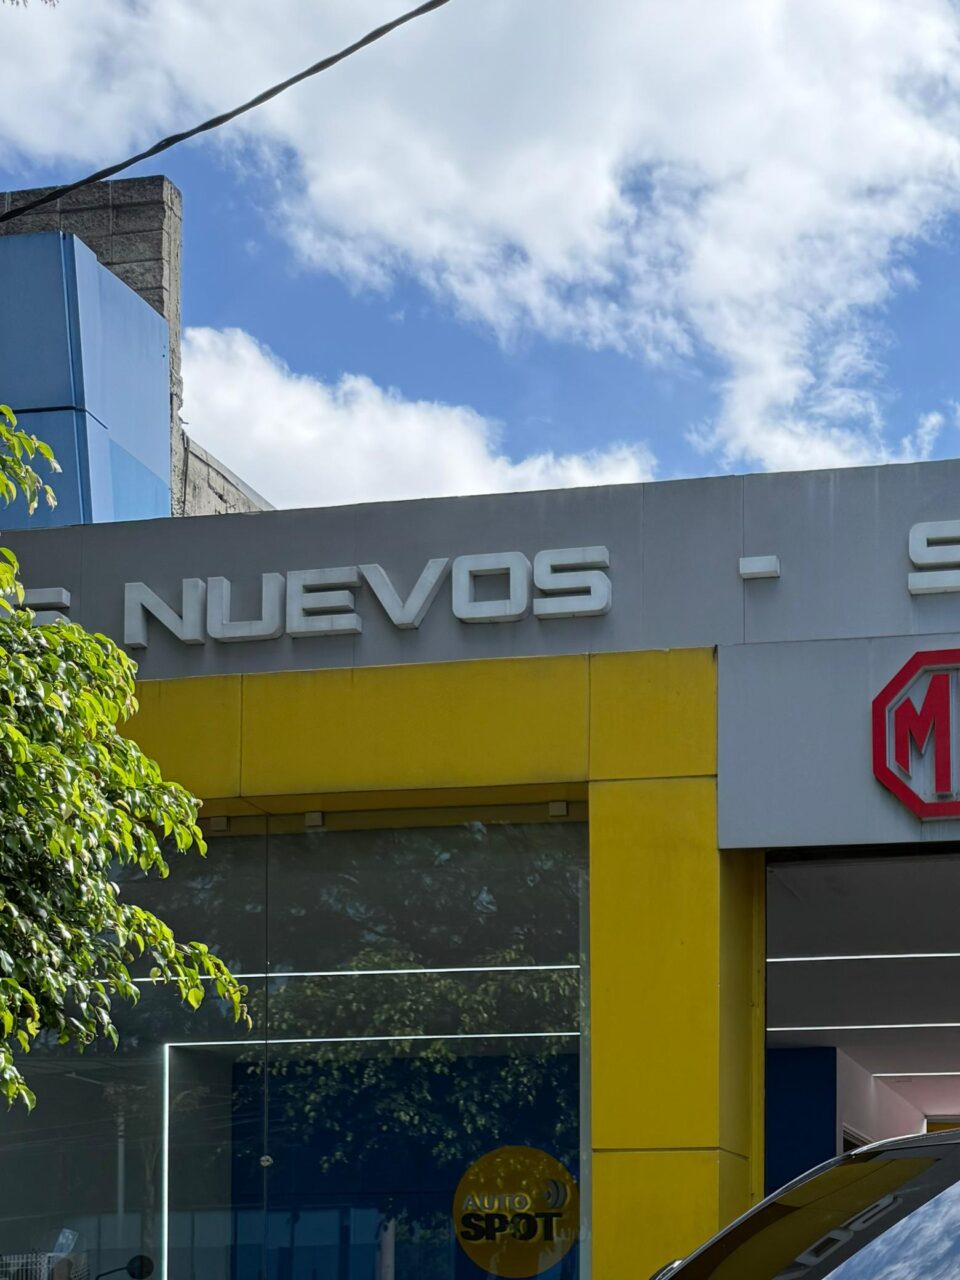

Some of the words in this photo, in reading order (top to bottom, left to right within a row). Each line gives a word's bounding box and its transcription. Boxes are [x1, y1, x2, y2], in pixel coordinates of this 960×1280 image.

[124, 545, 613, 649] NUEVOS
[462, 1193, 532, 1213] AUTO
[460, 1211, 564, 1242] SPOT
